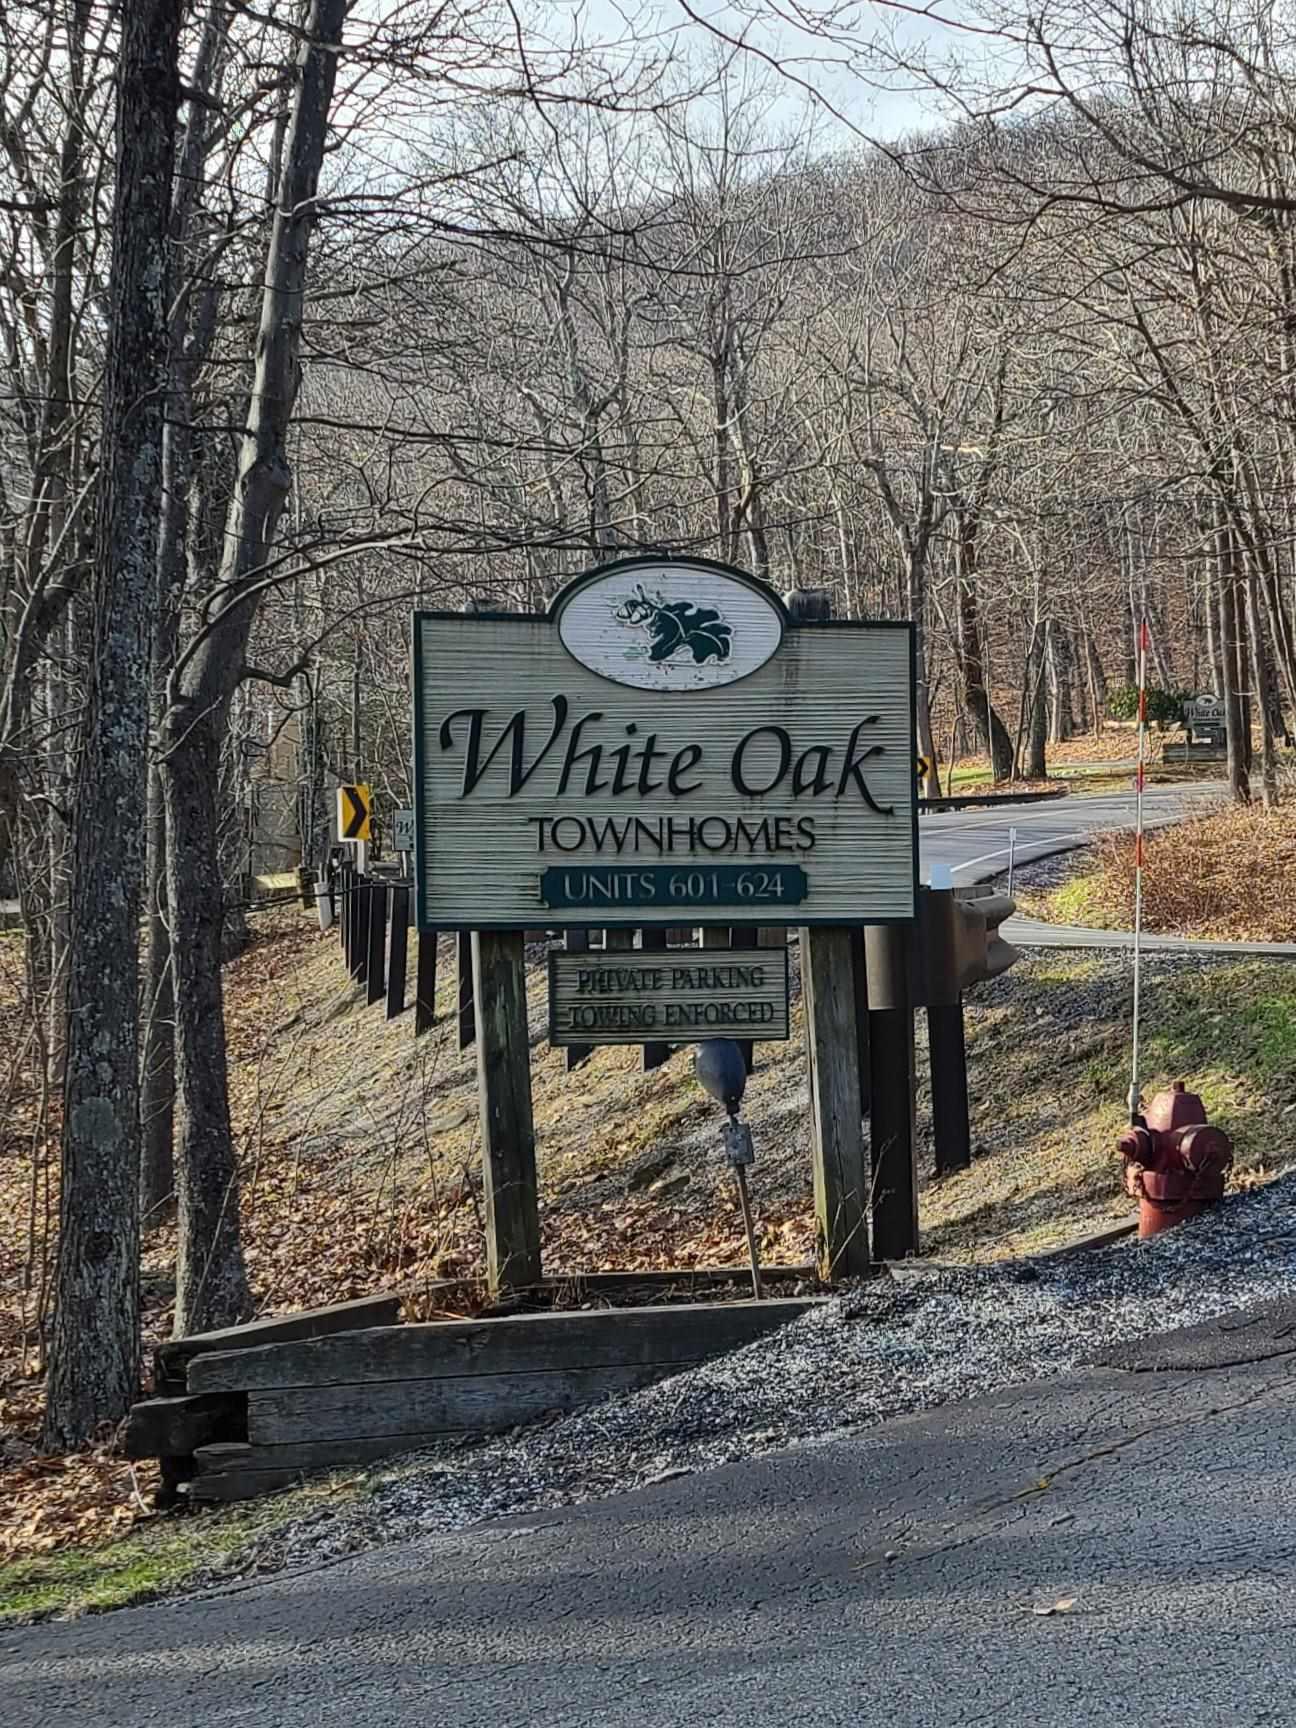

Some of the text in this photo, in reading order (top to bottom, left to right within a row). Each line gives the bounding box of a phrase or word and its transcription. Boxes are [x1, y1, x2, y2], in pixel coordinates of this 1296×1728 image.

[440, 694, 894, 816] White Oak
[533, 817, 816, 852] TOWNHOMES
[564, 871, 785, 900] UNITS 601-624
[575, 966, 765, 994] PRIVATE PARKING
[567, 1001, 774, 1030] TOWING ENFORCED
